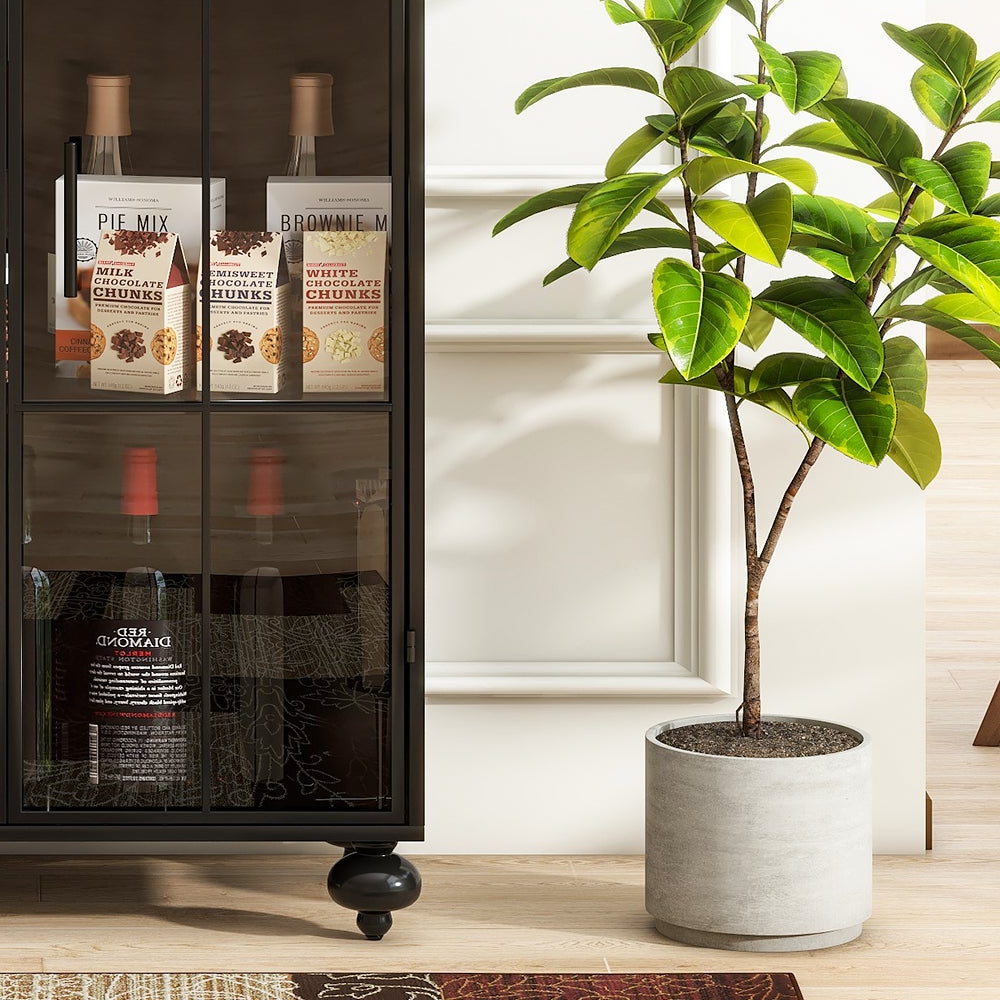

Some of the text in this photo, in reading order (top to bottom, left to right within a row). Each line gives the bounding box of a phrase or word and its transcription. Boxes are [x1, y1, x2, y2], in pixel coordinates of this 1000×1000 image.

[137, 215, 168, 232] MIX
[281, 214, 364, 232] BROWNIE
[96, 267, 134, 277] MILK
[201, 270, 274, 279] EMISWEET
[305, 269, 358, 278] WHITE
[94, 278, 164, 288] CHOCOLATE
[200, 280, 273, 288] HOCOLATE
[93, 287, 163, 301] CHUNKS
[199, 288, 272, 300] HUNKS
[305, 289, 381, 300] CHUNKS
